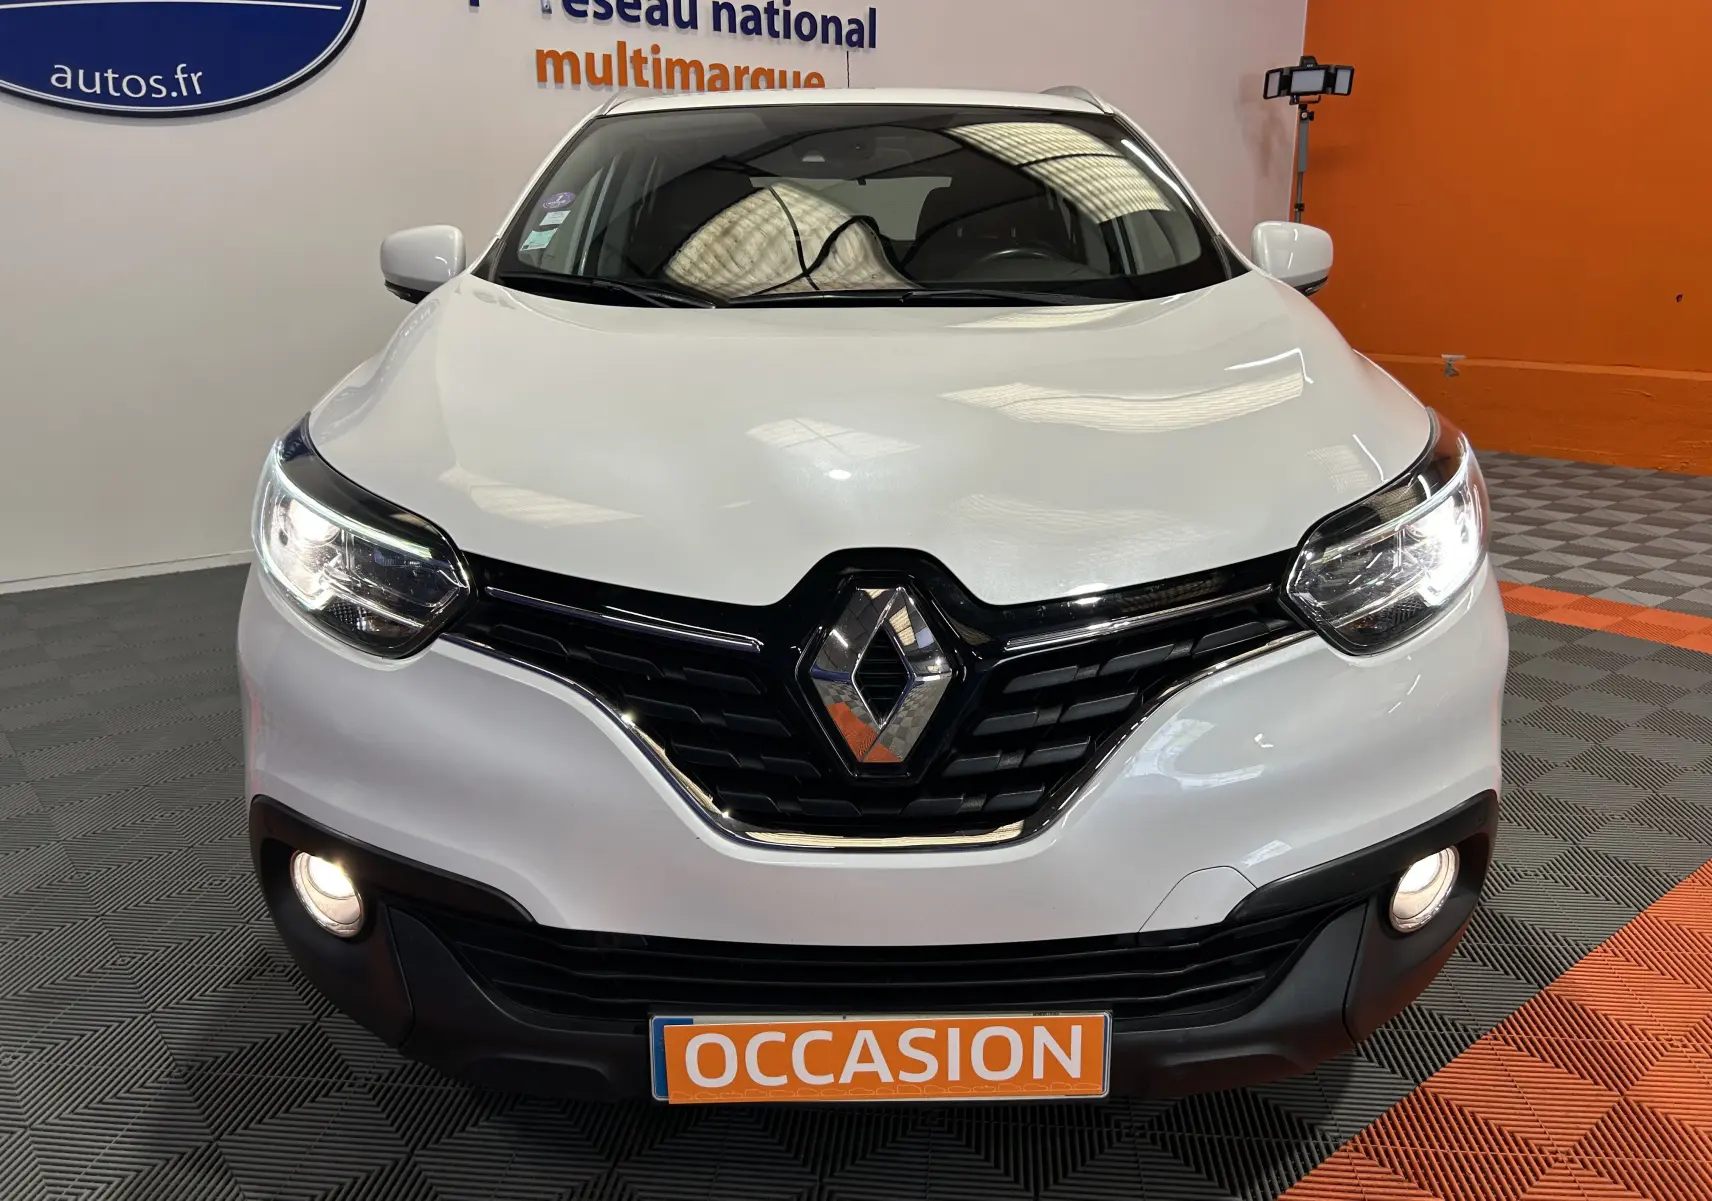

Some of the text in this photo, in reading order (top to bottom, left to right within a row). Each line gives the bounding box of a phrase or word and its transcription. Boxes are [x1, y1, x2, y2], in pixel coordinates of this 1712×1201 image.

[712, 0, 877, 49] national
[50, 64, 203, 98] autos.fr
[685, 1025, 1082, 1088] OCCASION
